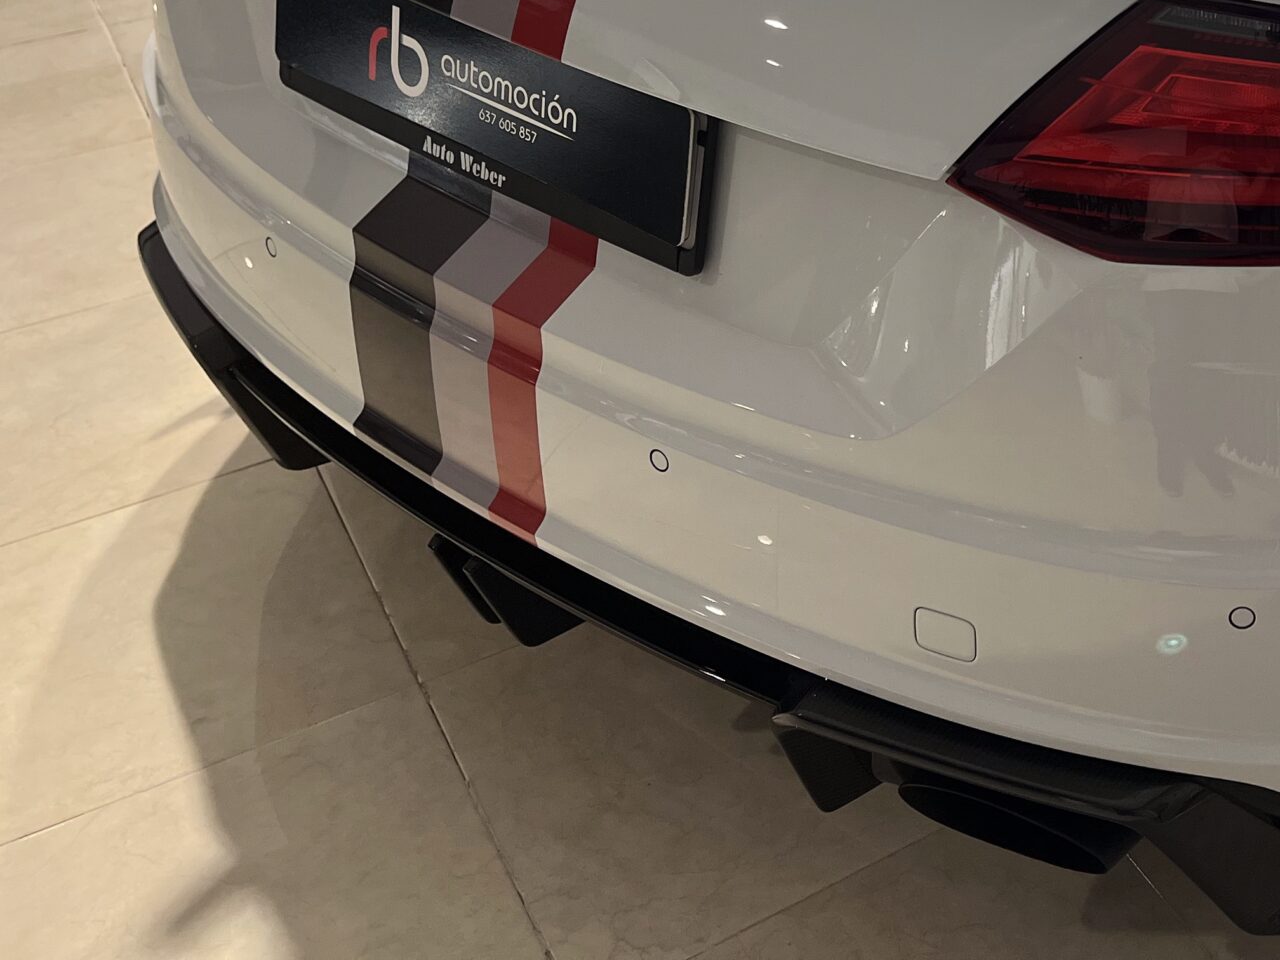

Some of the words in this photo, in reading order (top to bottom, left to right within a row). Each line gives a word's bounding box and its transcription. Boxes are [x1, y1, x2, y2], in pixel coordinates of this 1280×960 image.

[368, 4, 429, 97] rb
[441, 54, 577, 132] automoción
[479, 108, 497, 125] 637
[498, 117, 517, 135] 605
[518, 126, 537, 144] 857
[422, 135, 455, 164] Auto
[460, 150, 507, 188] Weber
